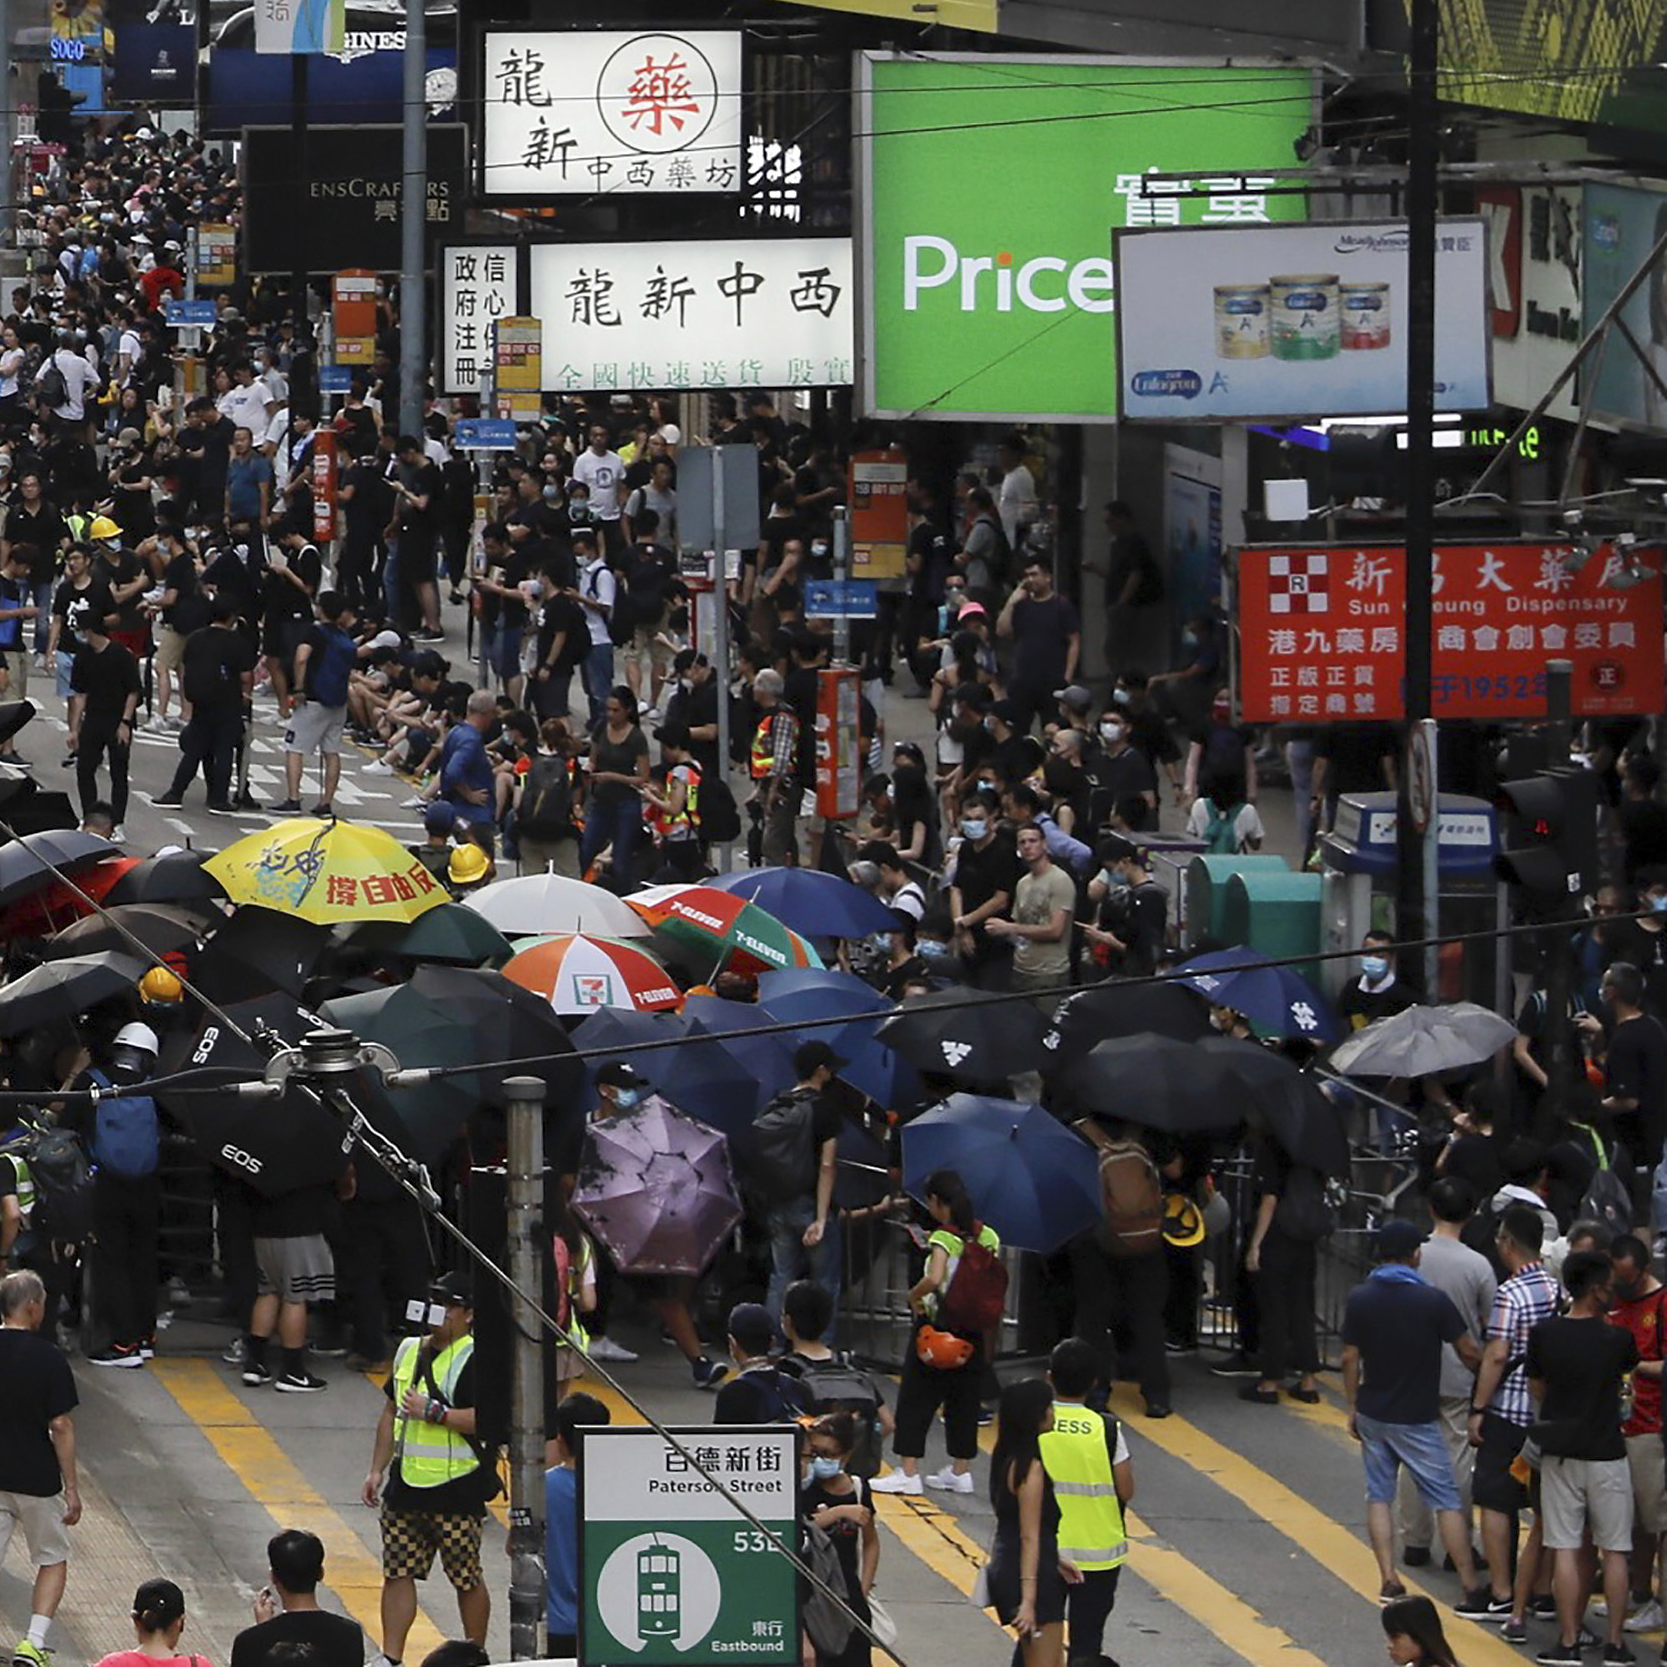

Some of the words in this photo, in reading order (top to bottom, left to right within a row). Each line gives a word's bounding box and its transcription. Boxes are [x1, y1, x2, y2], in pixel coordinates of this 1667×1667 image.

[50, 39, 86, 61] SOGO
[621, 52, 700, 136] 藥
[586, 156, 738, 193] 中西藥坊
[374, 198, 450, 222] 亮點
[904, 236, 1115, 313] Price
[564, 261, 842, 328] 龍新中西
[454, 253, 478, 386] 政府注冊
[558, 357, 764, 390] 全國快速送貨
[1349, 599, 1390, 615] Sun
[1505, 595, 1629, 616] Dispensary
[1268, 622, 1636, 655] 港九藥房商會創會委員
[1269, 664, 1376, 688] 正版正貨
[1269, 694, 1376, 717] 指定商號
[734, 928, 788, 965] 7-ELEVEN
[633, 986, 678, 1008] 7-ELEVEN
[191, 1026, 220, 1065] EOS
[220, 1141, 264, 1176] EOS
[664, 1445, 782, 1473] 百德新街
[648, 1479, 724, 1494] Paterson
[729, 1479, 783, 1494] Street
[733, 1531, 784, 1553] 53E
[751, 1620, 784, 1637] 東行
[710, 1640, 785, 1653] Eastbound
